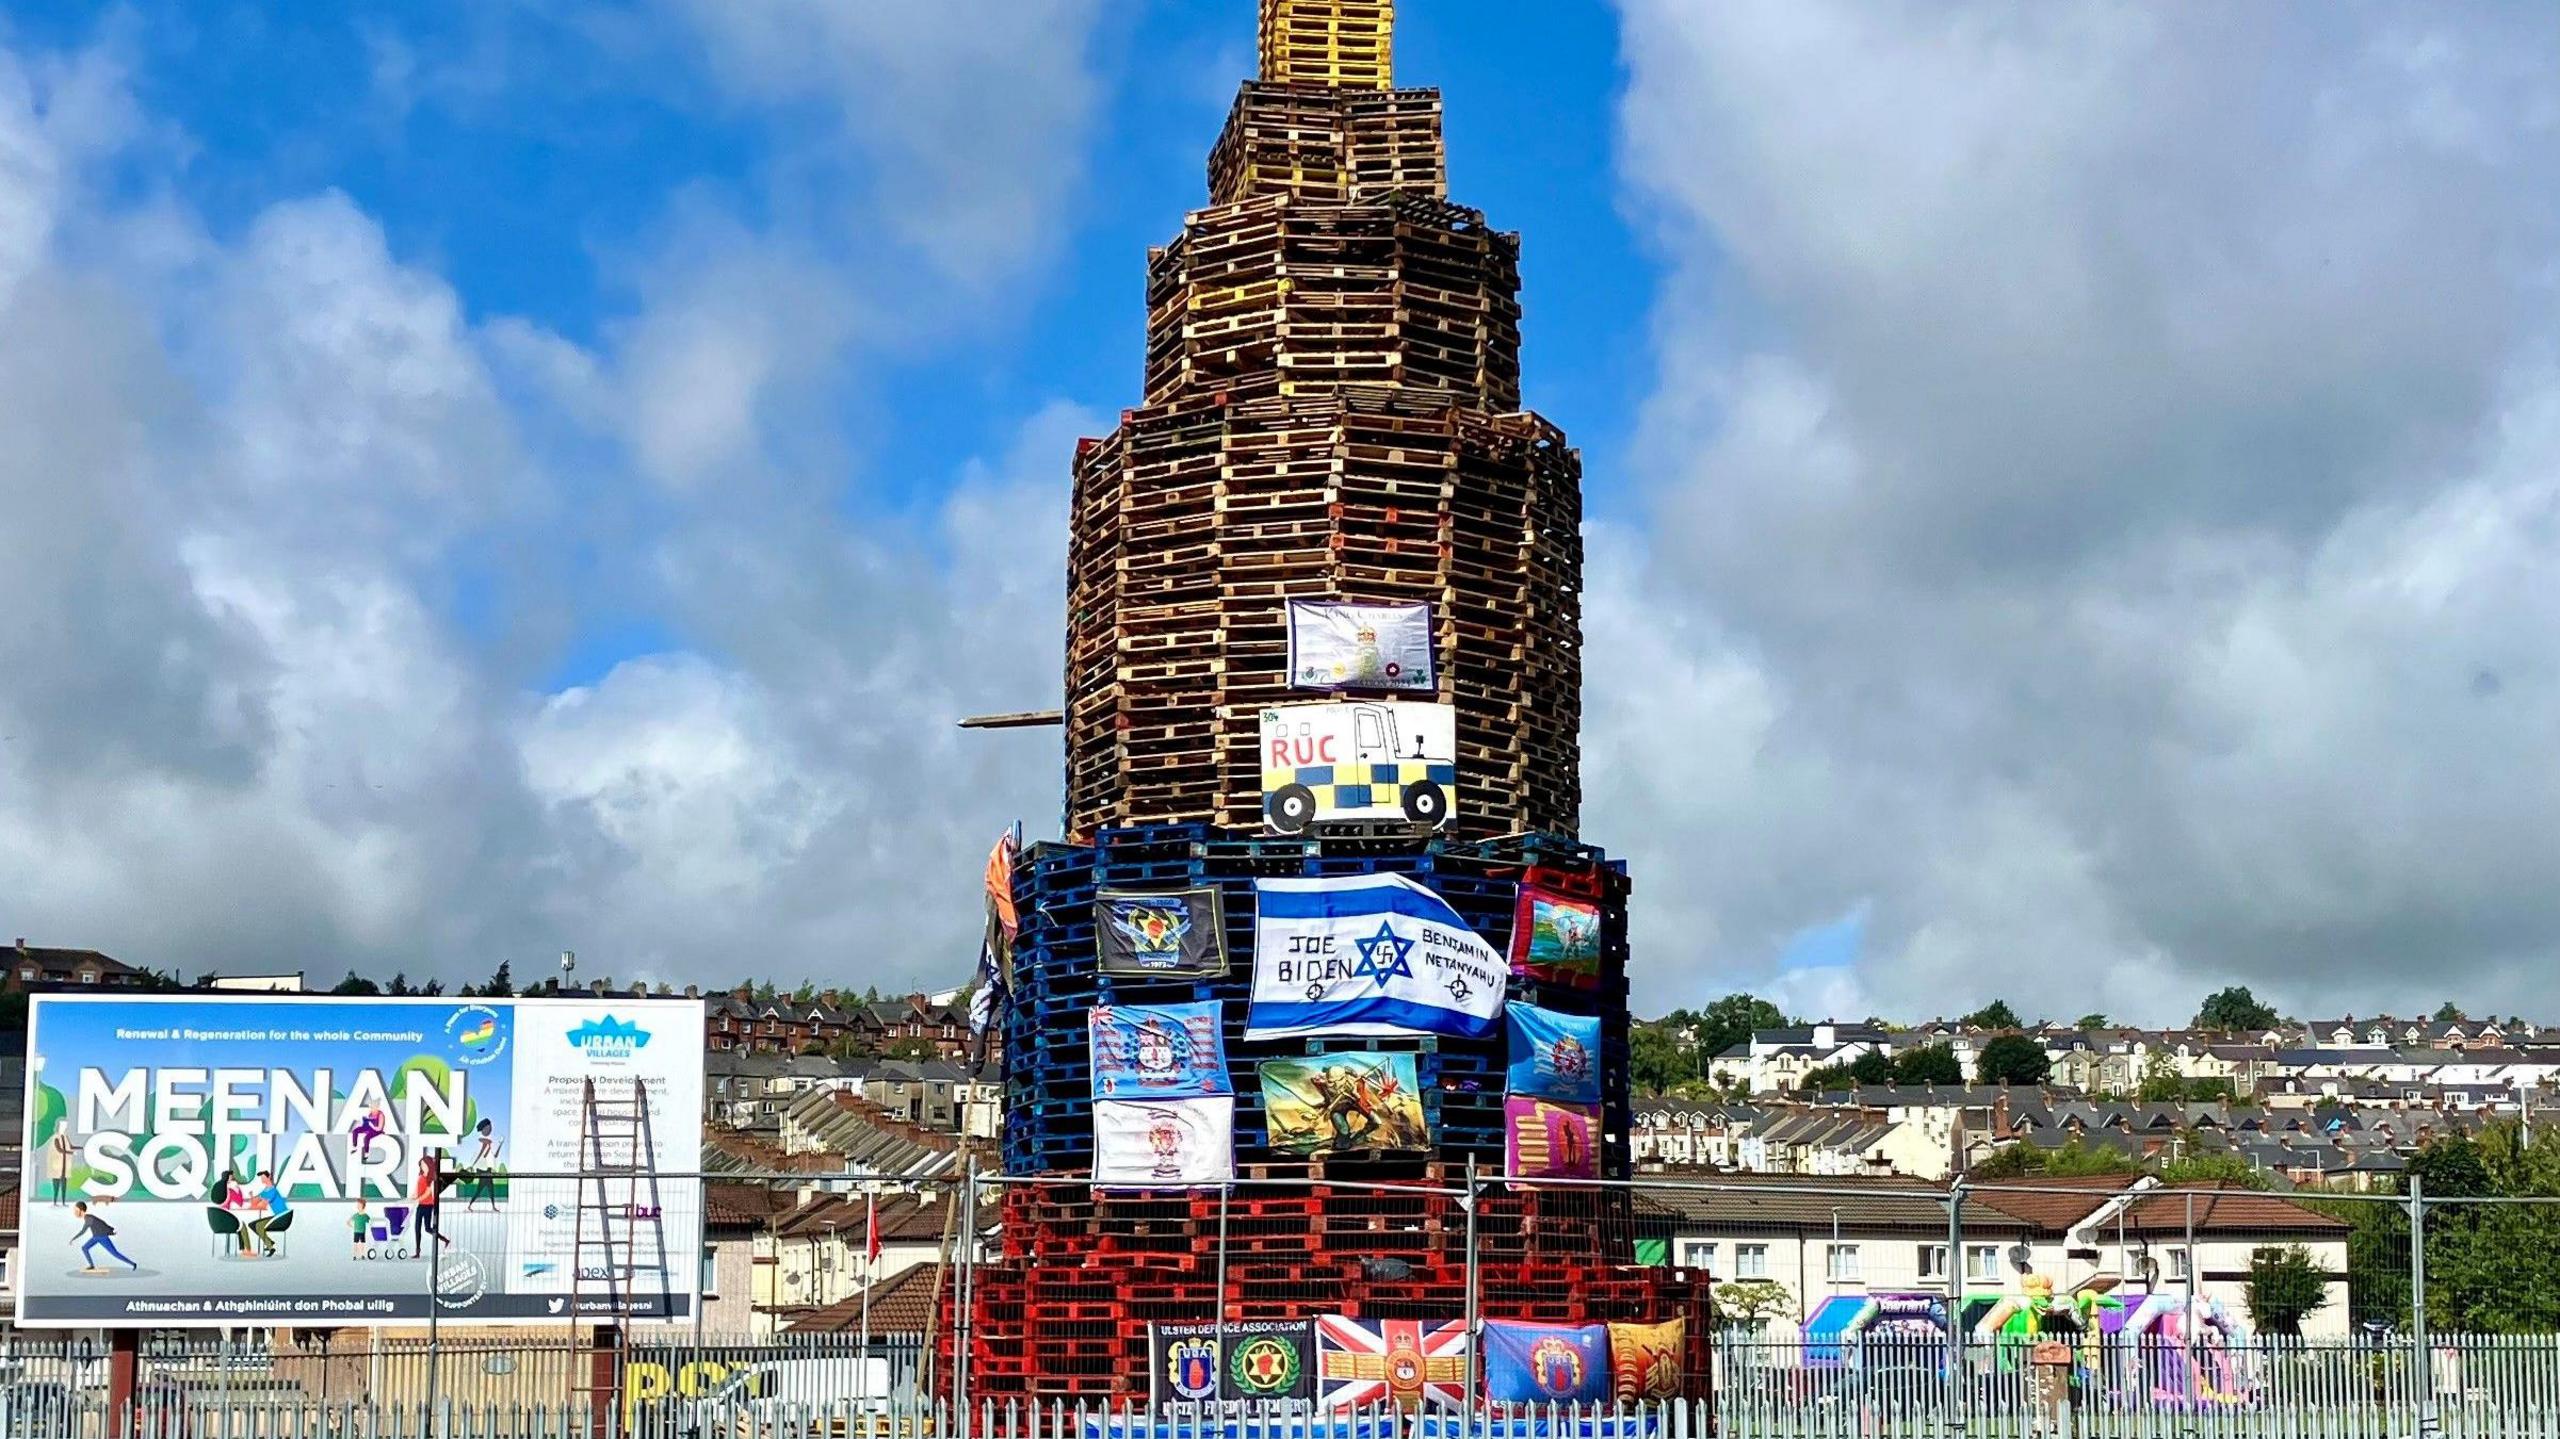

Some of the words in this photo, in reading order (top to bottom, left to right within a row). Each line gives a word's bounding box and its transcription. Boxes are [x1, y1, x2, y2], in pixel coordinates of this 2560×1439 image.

[1271, 734, 1336, 768] RUC
[1288, 935, 1337, 954] JOE
[1422, 928, 1489, 962] BENJAMIN
[1278, 957, 1353, 982] BIDEN
[1425, 951, 1495, 988] NETANYAHU
[116, 1028, 168, 1040] Renewal
[171, 1029, 181, 1040] &
[183, 1029, 266, 1042] Regeneration
[269, 1030, 287, 1041] for
[290, 1030, 310, 1041] the
[313, 1030, 350, 1041] whole
[353, 1031, 423, 1043] Community
[580, 1034, 637, 1048] URBAN
[586, 1049, 630, 1058] VILLAGES
[548, 1075, 597, 1085] Proposd
[600, 1075, 666, 1085] Develoment
[77, 1067, 467, 1136] MEENAN
[80, 1131, 459, 1200] SQUARE
[126, 1299, 200, 1312] Athnuachan
[203, 1300, 212, 1311] &
[294, 1300, 319, 1312] don
[322, 1300, 364, 1312] Phobal
[367, 1300, 394, 1313] uilig
[1161, 1325, 1197, 1336] ULSTER
[1198, 1322, 1240, 1335] DEFNCE
[1241, 1321, 1307, 1333] ASSOCIATION
[1183, 1349, 1208, 1358] UDA
